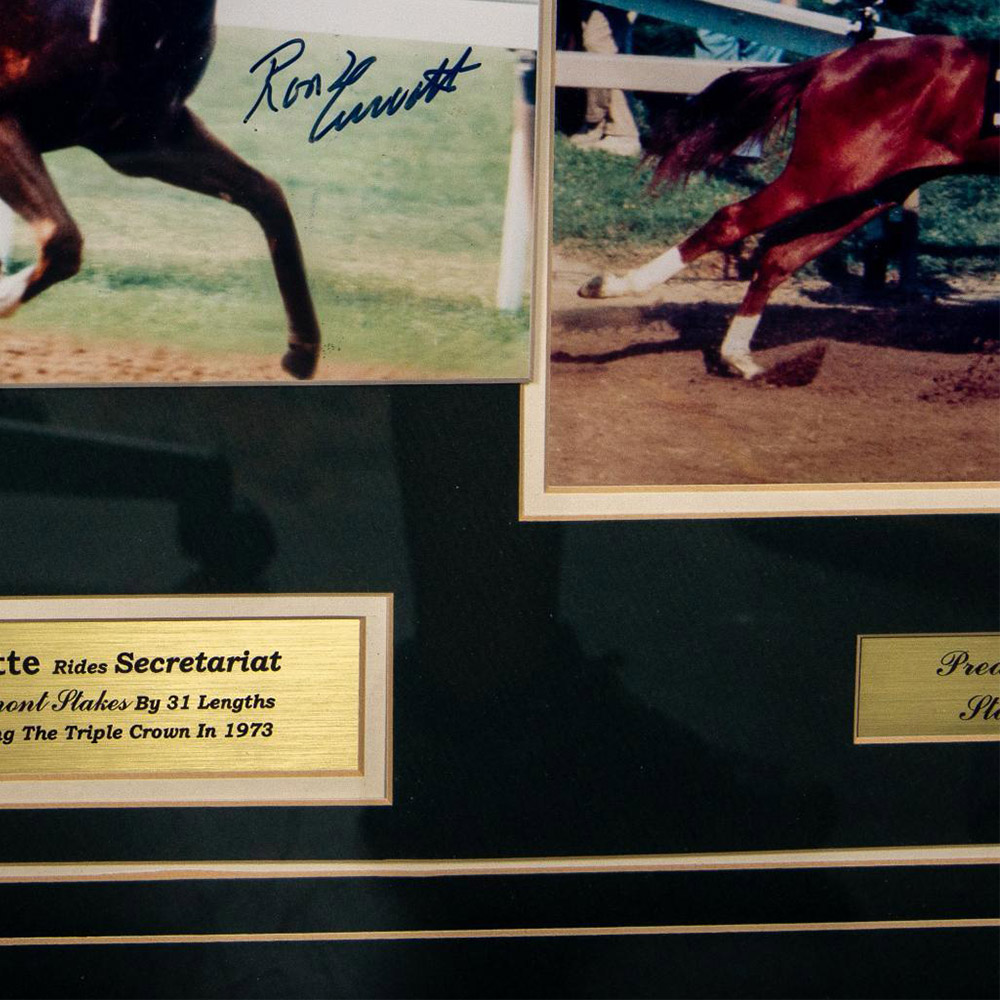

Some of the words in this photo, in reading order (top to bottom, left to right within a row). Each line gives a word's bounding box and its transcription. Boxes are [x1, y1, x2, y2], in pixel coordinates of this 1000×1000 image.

[52, 659, 108, 675] Rides
[114, 650, 282, 674] Secretariat
[51, 688, 134, 712] Stakes
[134, 695, 161, 714] By
[166, 695, 190, 711] 31
[197, 693, 277, 713] Lengths
[22, 725, 59, 741] The
[64, 724, 124, 744] Triple
[129, 724, 191, 740] Crown
[196, 723, 217, 738] In
[224, 722, 274, 738] 1973
